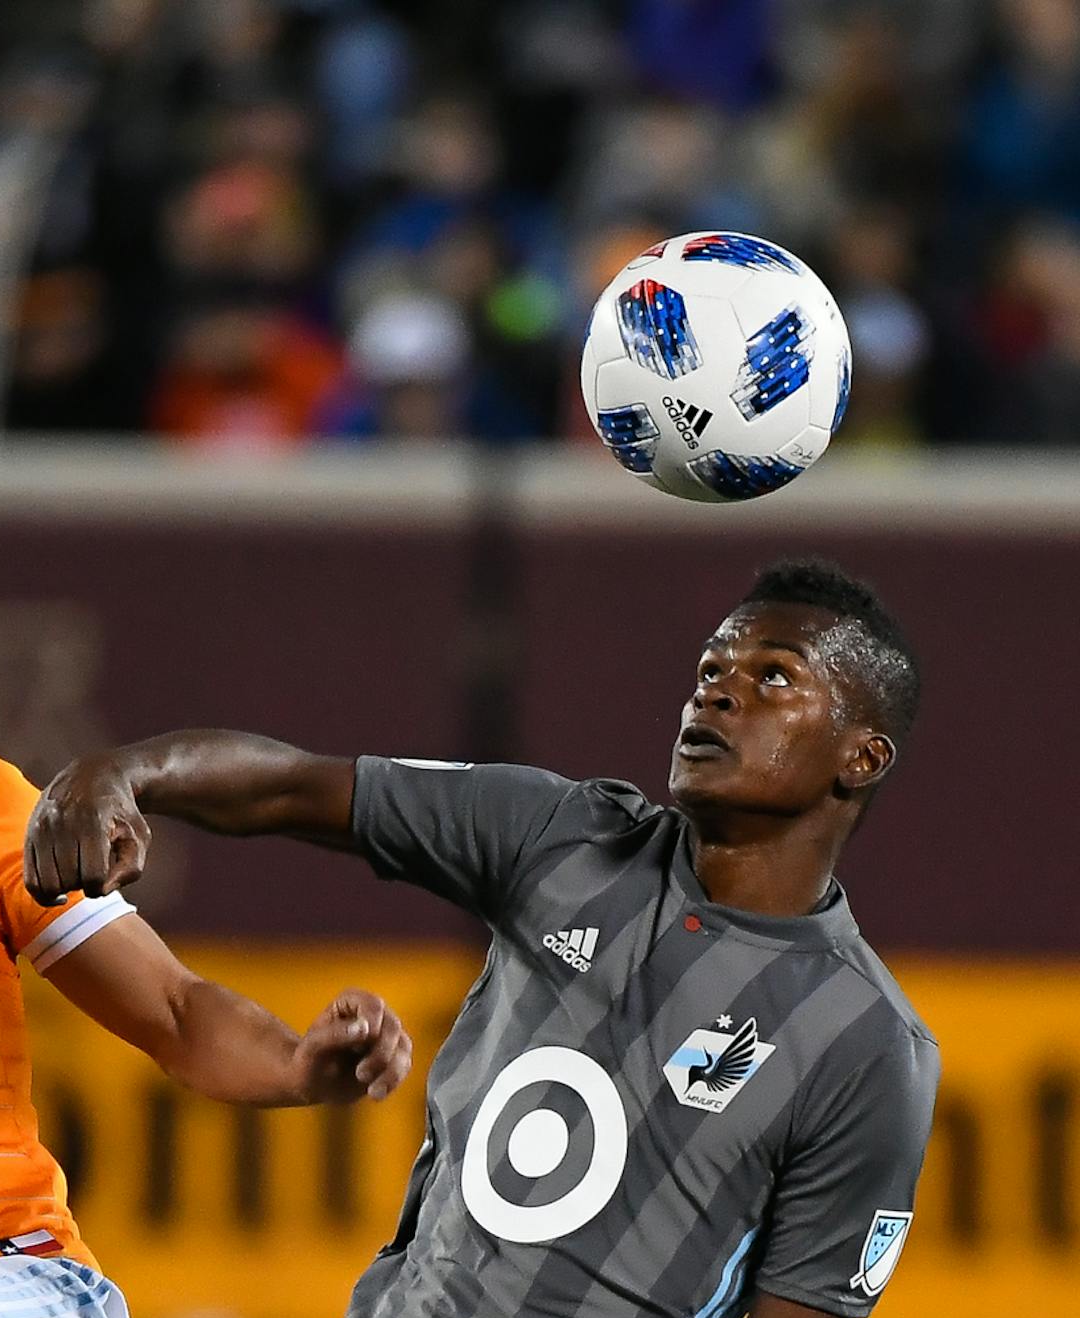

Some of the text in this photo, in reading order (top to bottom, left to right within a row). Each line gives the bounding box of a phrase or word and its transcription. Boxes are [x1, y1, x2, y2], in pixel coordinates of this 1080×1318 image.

[662, 396, 699, 450] adidas
[542, 934, 592, 973] adidas
[874, 1221, 896, 1237] MLS
